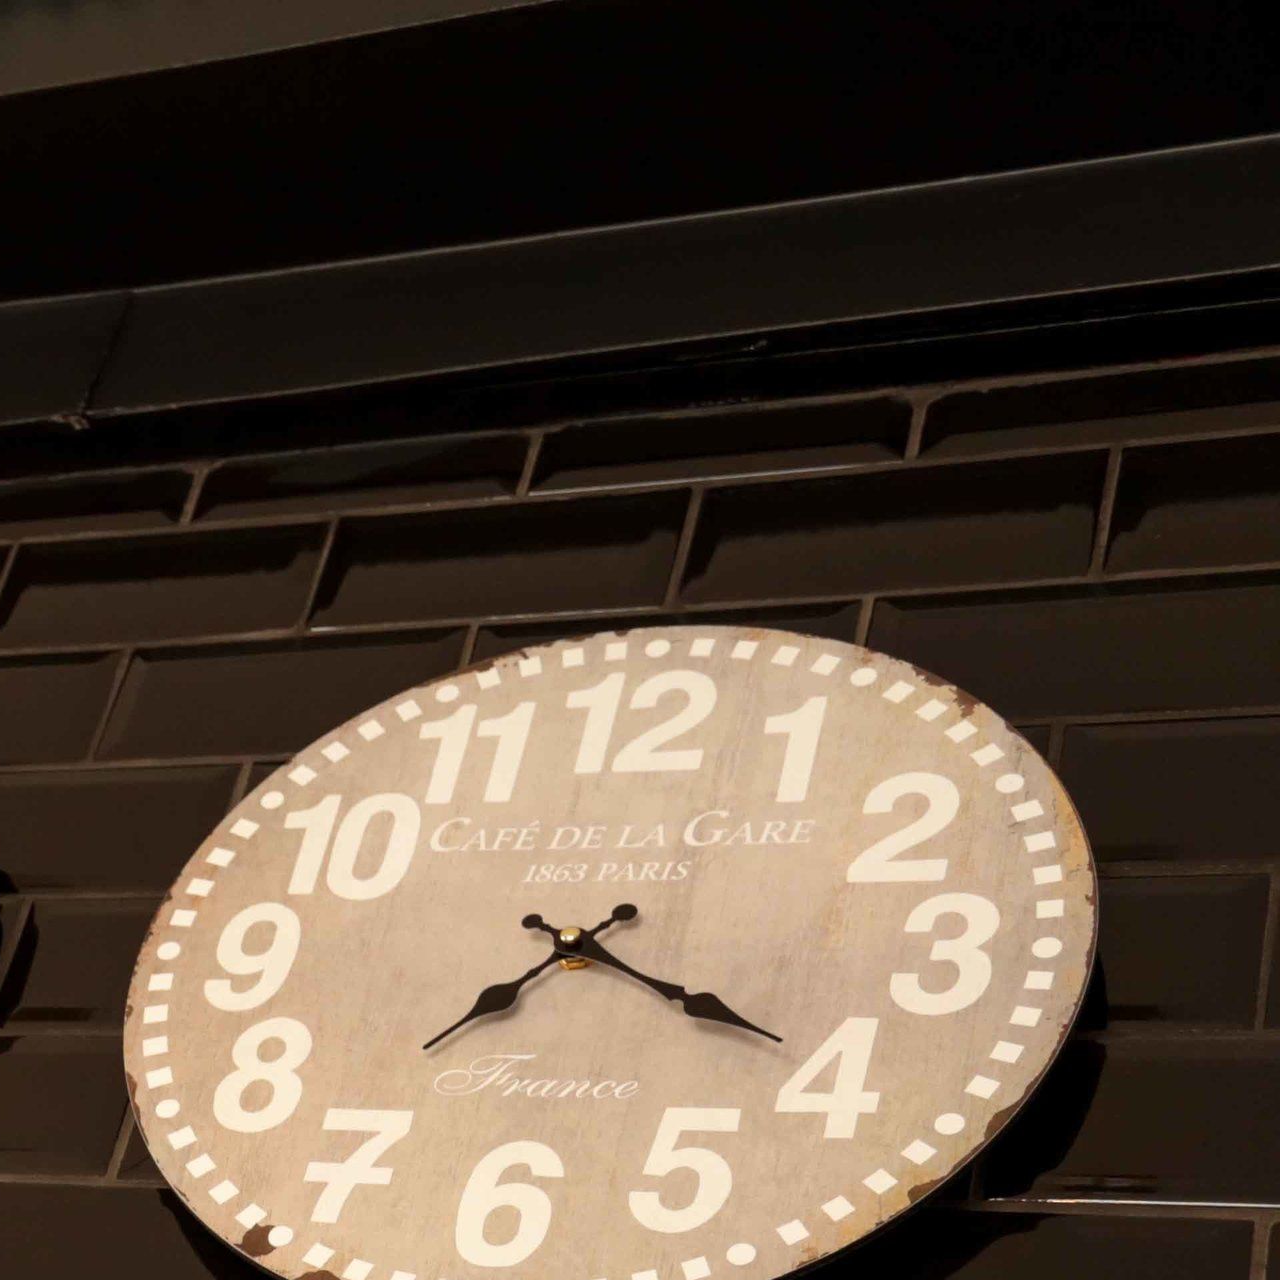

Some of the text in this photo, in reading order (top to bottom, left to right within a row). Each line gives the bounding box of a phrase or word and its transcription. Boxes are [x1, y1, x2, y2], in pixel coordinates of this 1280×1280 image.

[420, 702, 535, 803] 11
[566, 670, 717, 773] 12
[764, 696, 828, 802] 1
[284, 793, 421, 900] 10
[428, 808, 817, 853] CAFÉ DE LA GARE
[521, 859, 693, 884] 1863 PARIS
[847, 772, 960, 882] 2
[204, 902, 301, 1011] 9
[890, 892, 1001, 1015] 3
[213, 1017, 313, 1133] 8
[433, 1053, 641, 1100] France
[775, 1017, 880, 1138] 4
[303, 1108, 414, 1223] 7
[455, 1140, 564, 1267] 6
[629, 1107, 742, 1233] 5
